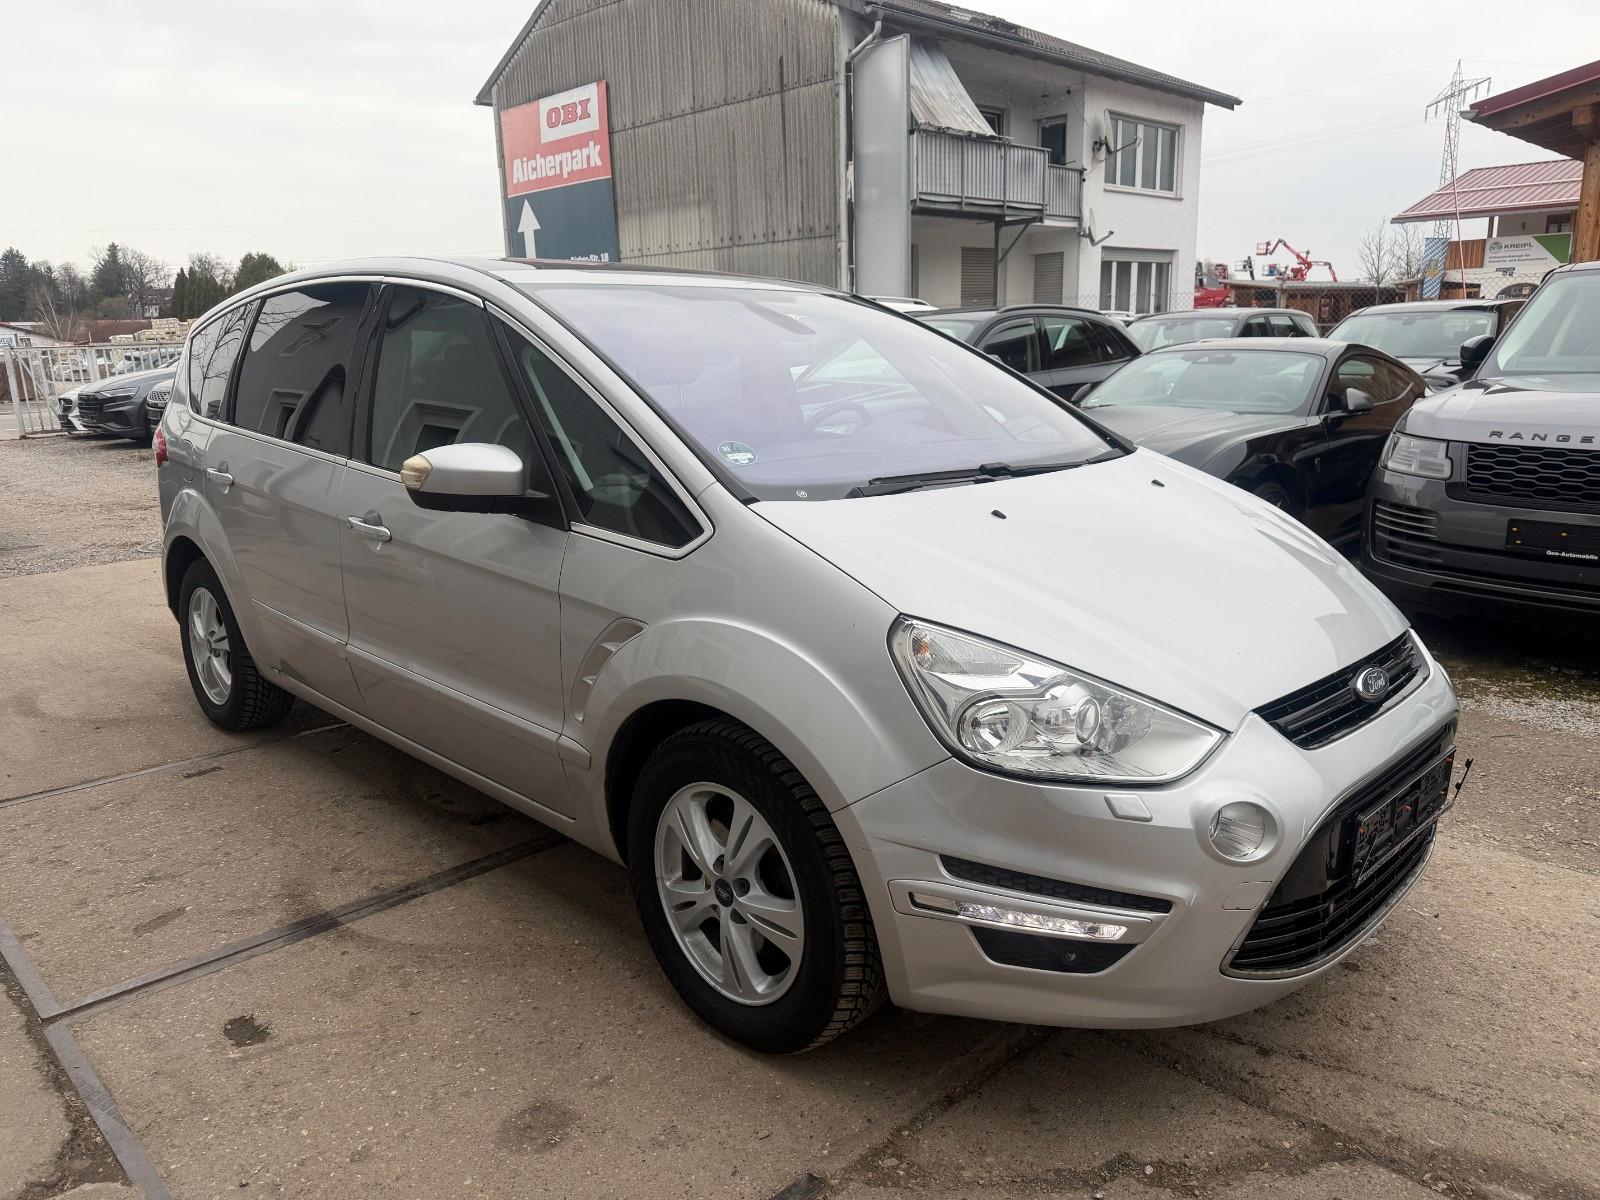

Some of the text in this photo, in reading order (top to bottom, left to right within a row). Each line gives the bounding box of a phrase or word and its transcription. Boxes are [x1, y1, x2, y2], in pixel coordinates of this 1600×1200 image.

[546, 98, 591, 129] OBI
[513, 140, 602, 184] Aicherpark
[1488, 430, 1596, 444] RANGE
[1367, 671, 1386, 693] Ford
